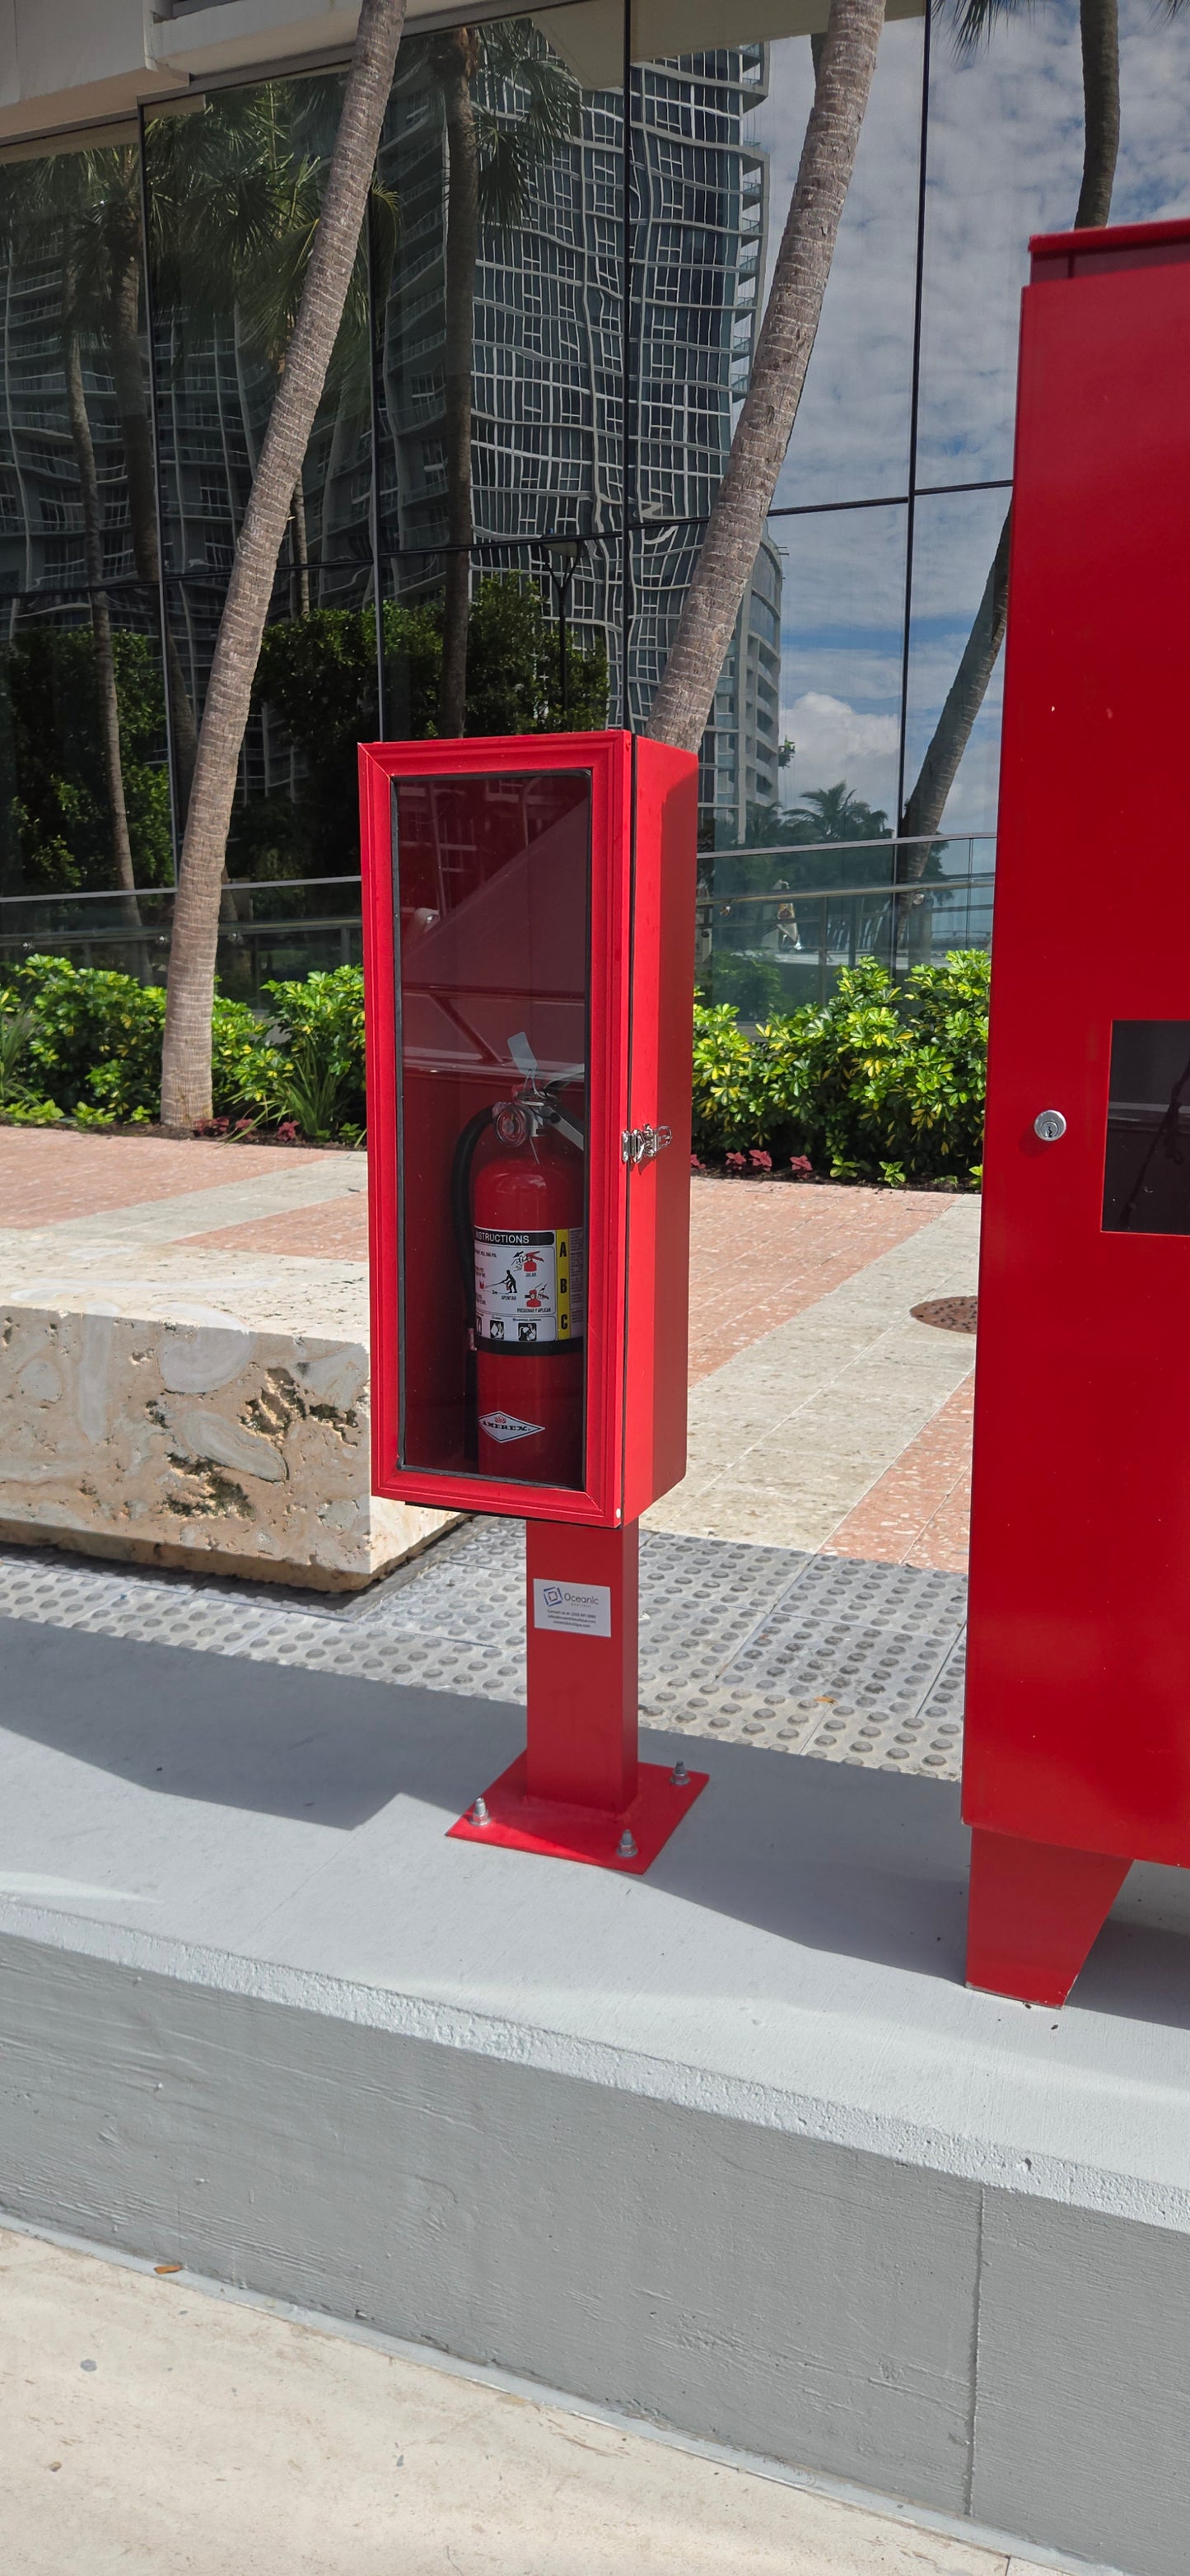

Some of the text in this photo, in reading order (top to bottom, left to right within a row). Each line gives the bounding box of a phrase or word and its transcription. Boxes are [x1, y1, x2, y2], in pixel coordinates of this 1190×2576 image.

[475, 1231, 530, 1244] NSTRUCTIONS
[559, 1242, 567, 1258] A
[560, 1278, 567, 1294] B
[561, 1314, 568, 1330] C
[482, 1421, 527, 1431] AMEREX
[564, 1593, 599, 1605] Oceanic
